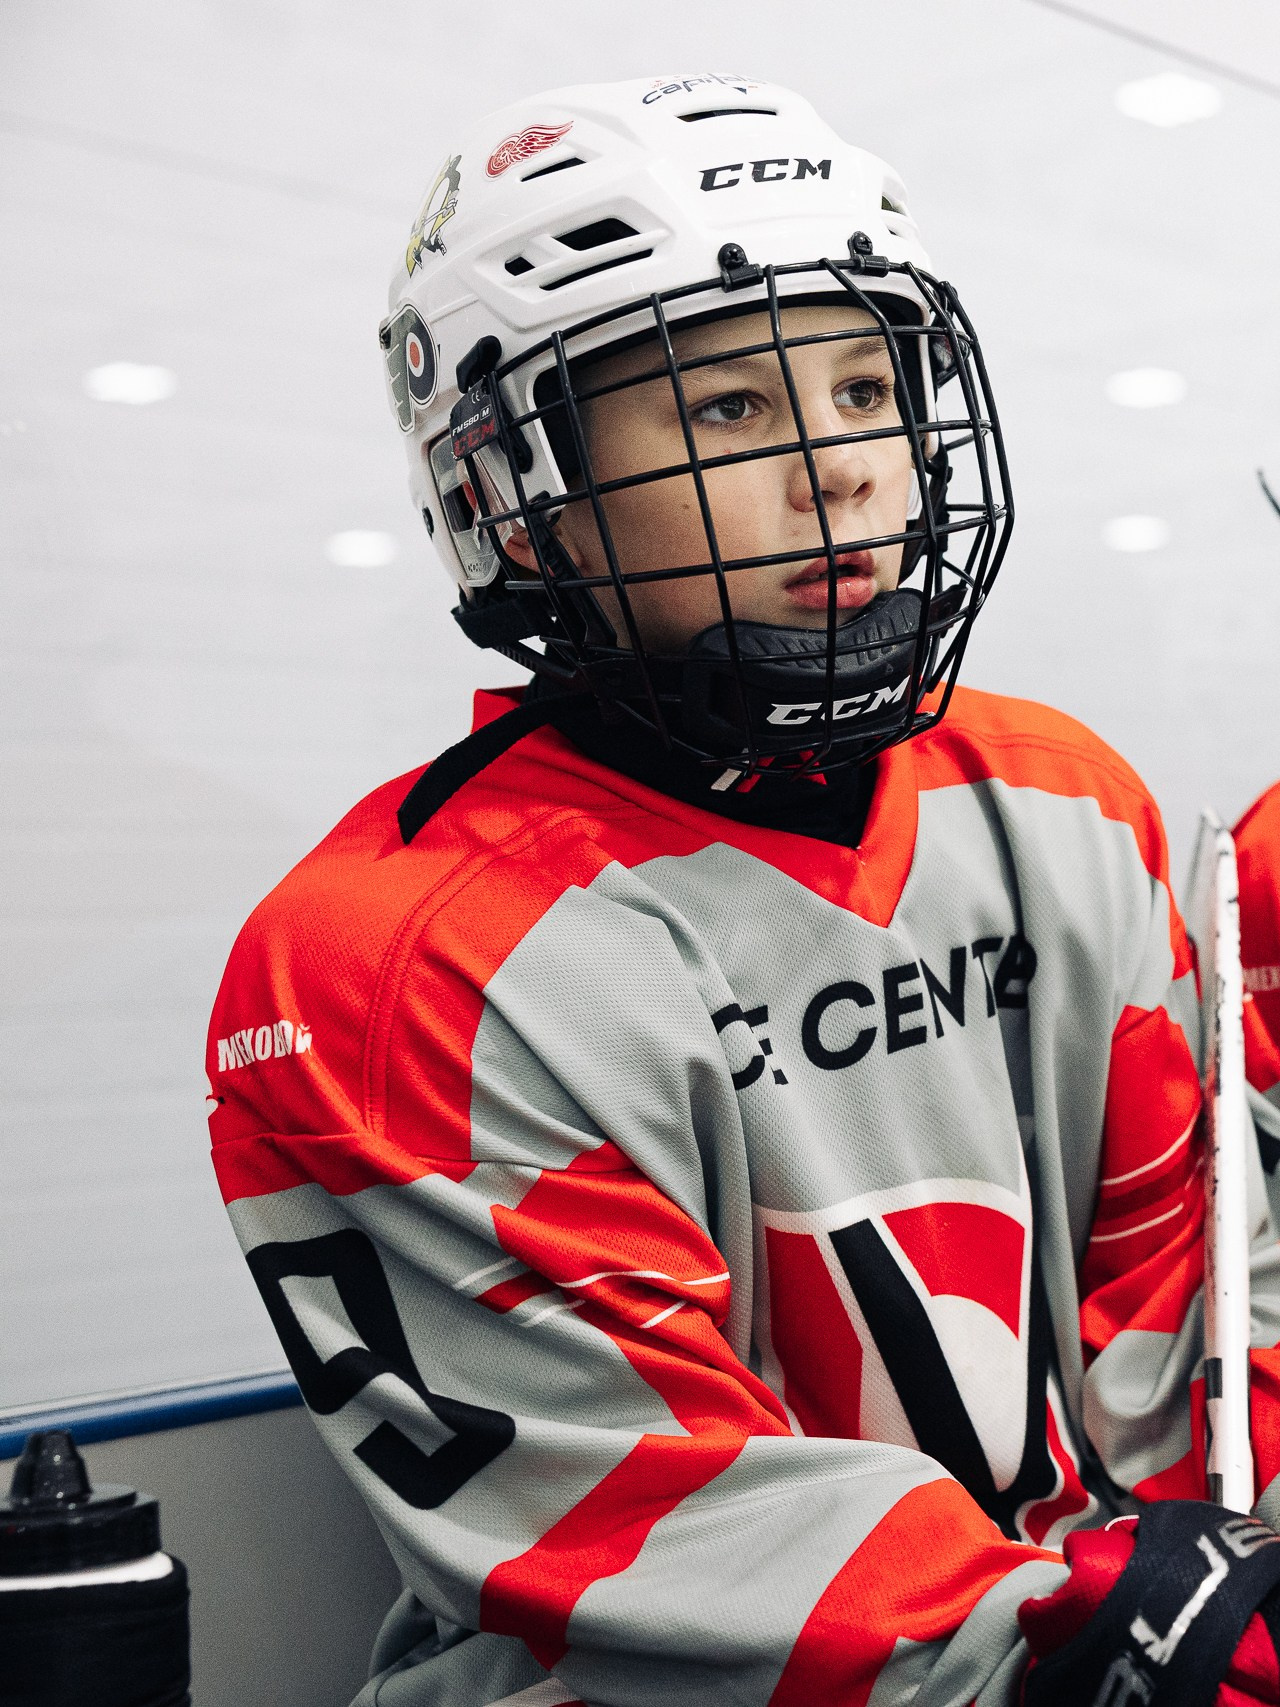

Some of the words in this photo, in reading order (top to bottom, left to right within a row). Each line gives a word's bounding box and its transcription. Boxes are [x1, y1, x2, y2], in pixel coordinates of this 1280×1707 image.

[698, 157, 832, 192] CCM
[453, 417, 496, 457] CCM
[766, 674, 911, 725] CCM
[246, 1229, 516, 1509] 9
